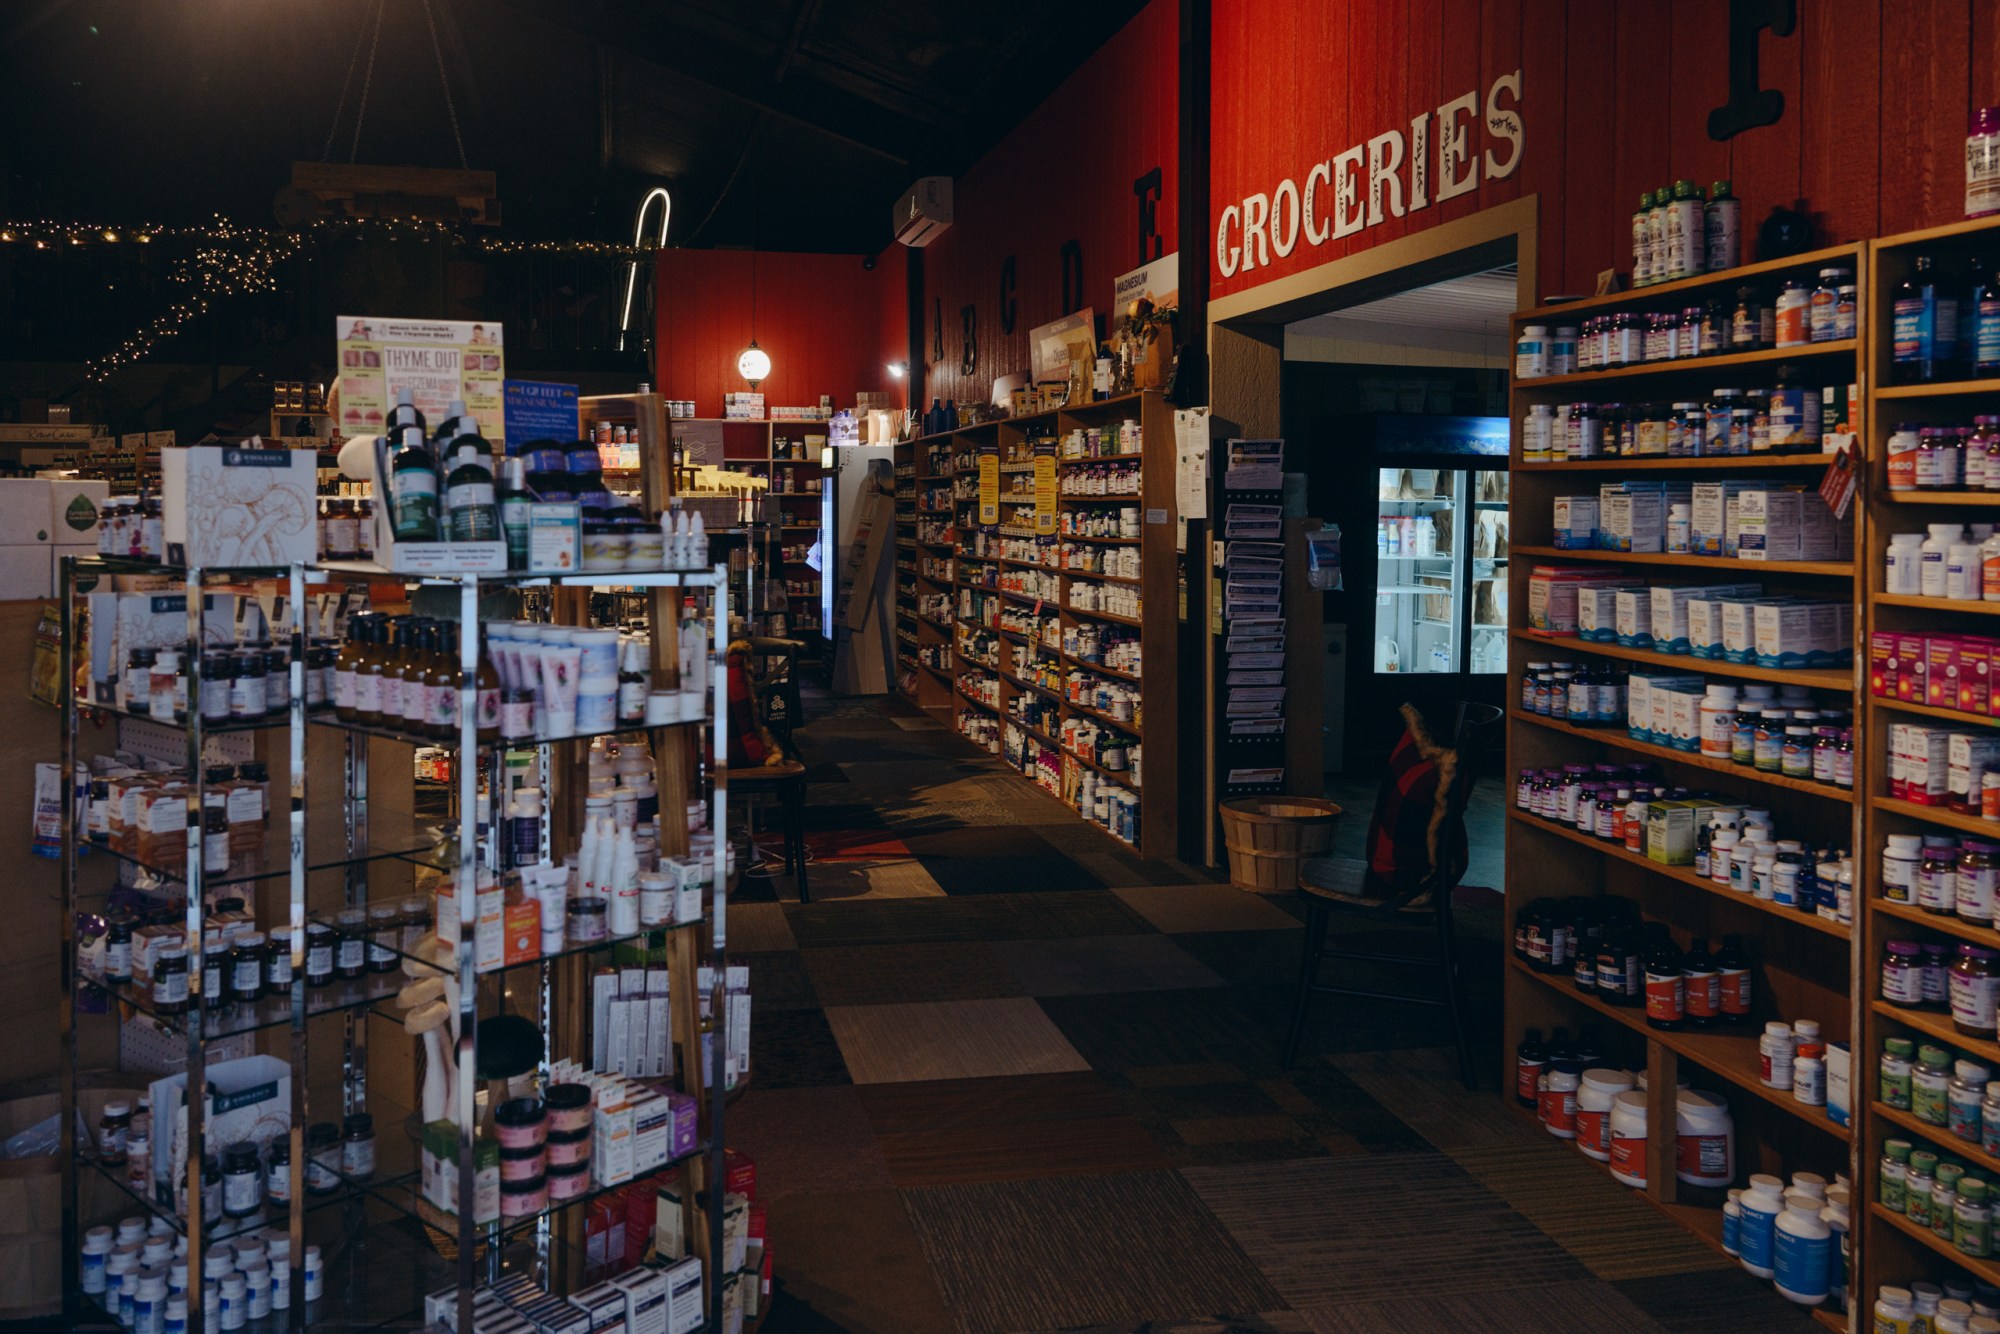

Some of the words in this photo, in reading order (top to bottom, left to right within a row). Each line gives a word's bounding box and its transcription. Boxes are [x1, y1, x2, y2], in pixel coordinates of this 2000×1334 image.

[1216, 68, 1525, 279] GROCERIES
[1133, 166, 1163, 268] E
[1001, 254, 1016, 336] C
[1060, 238, 1083, 316] D
[1116, 270, 1149, 295] MAGNESIUM
[386, 349, 432, 368] THYME
[435, 351, 460, 369] OUT
[933, 297, 944, 363] A
[961, 303, 976, 375] B
[1258, 442, 1272, 451] Gold
[1740, 505, 1764, 514] OMEGA
